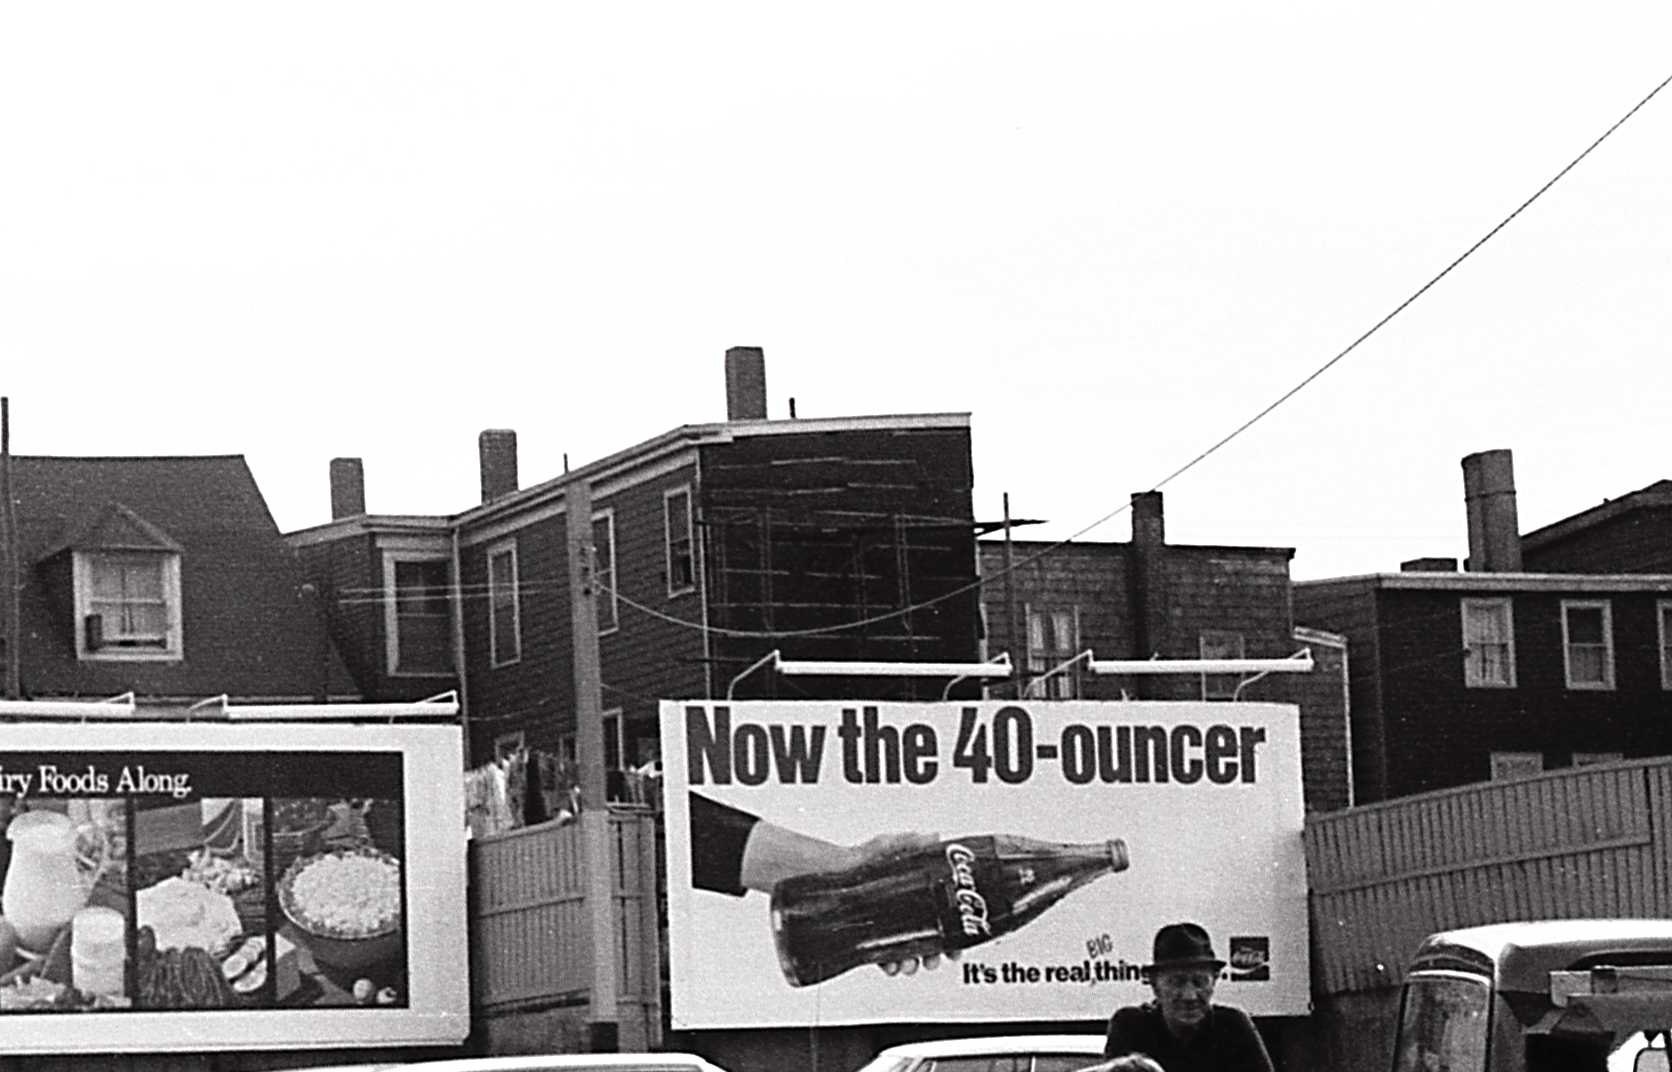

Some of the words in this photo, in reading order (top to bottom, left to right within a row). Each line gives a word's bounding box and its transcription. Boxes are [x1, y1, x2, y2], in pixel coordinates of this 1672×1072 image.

[686, 706, 826, 785] Now
[838, 708, 938, 784] the
[953, 706, 1265, 785] 40-ouncer
[38, 765, 108, 793] Foods
[116, 765, 193, 798] Along.
[1086, 933, 1114, 959] BIG
[962, 962, 997, 985] It's
[1002, 961, 1040, 984] the
